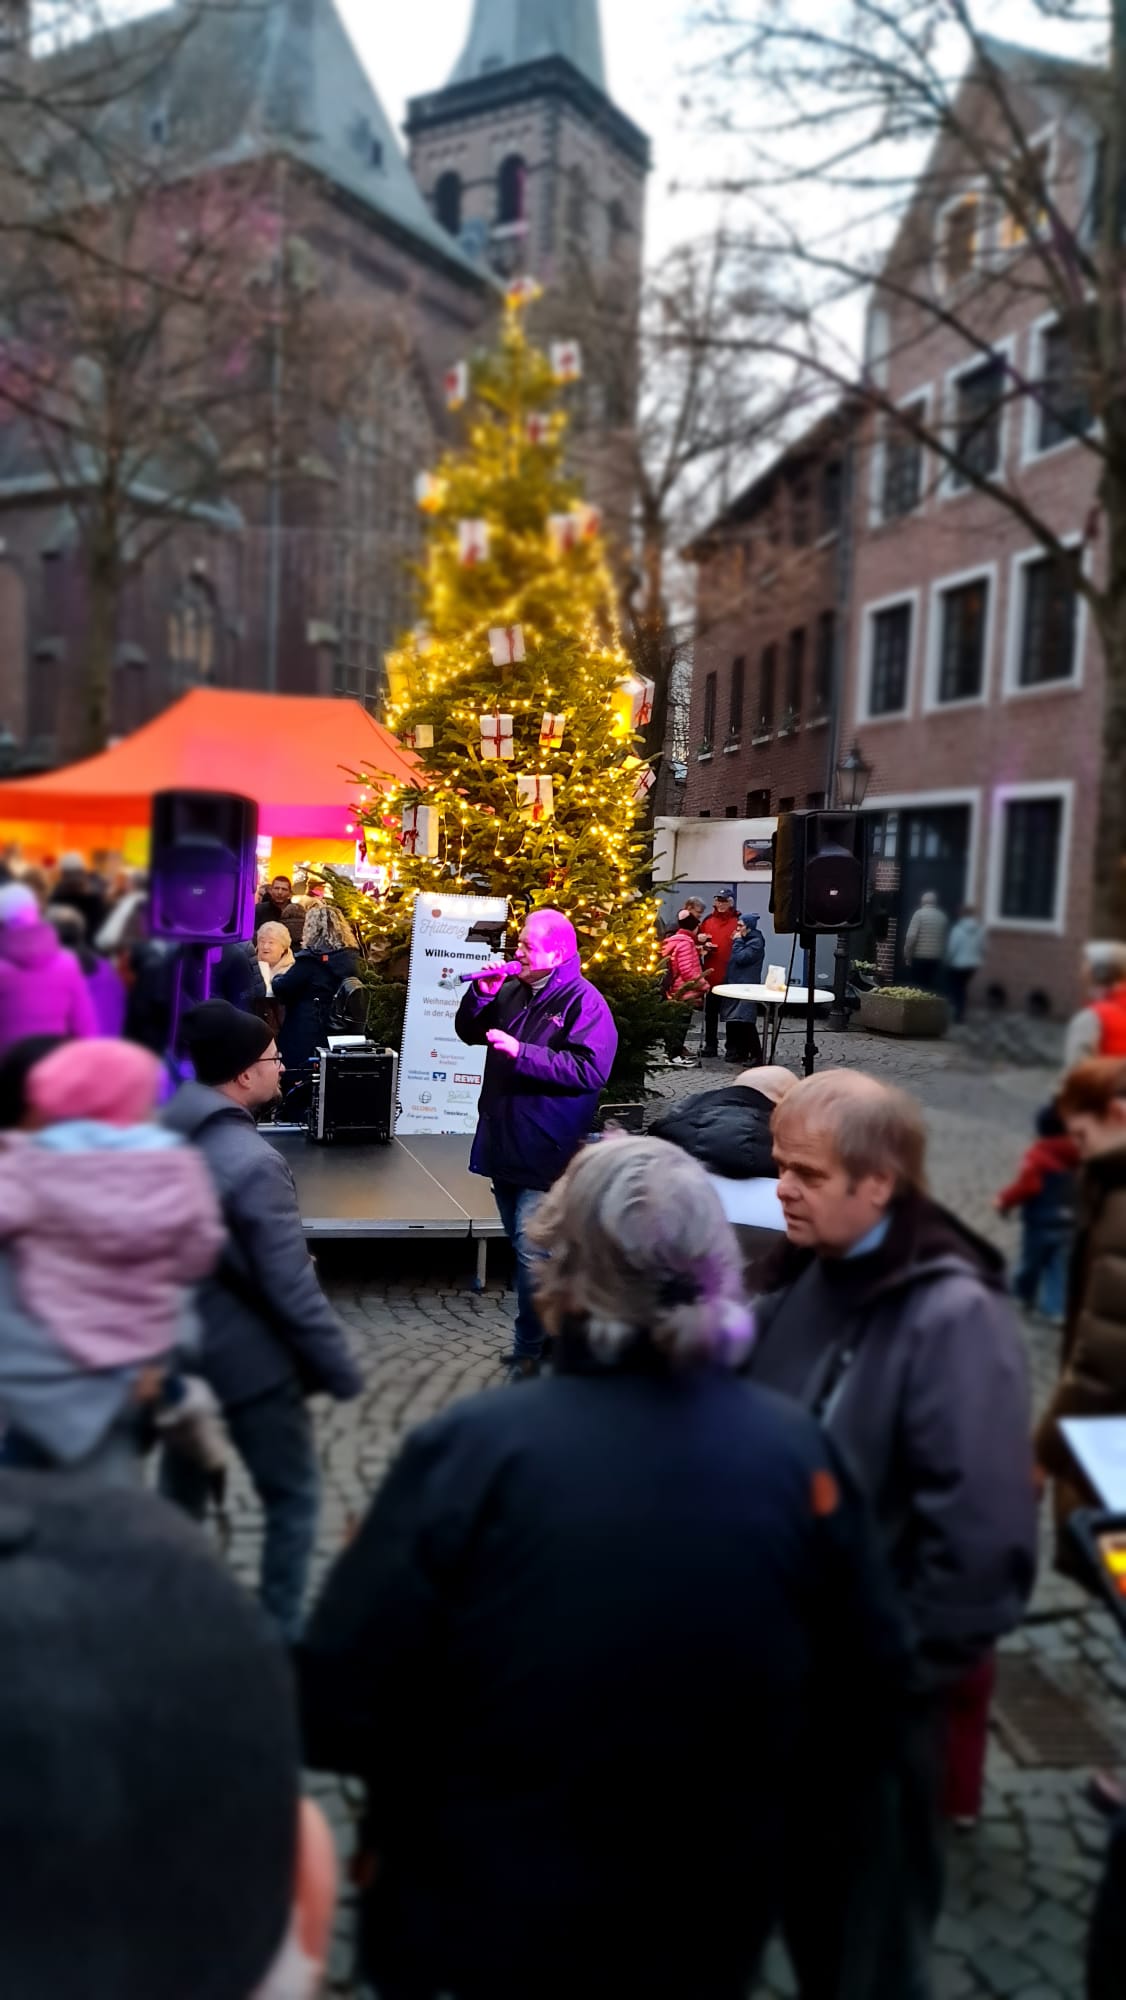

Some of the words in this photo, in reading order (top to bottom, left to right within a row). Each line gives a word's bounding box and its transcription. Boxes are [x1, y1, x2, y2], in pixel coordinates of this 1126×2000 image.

[425, 948, 491, 961] Willkommen!
[422, 997, 460, 1006] Weihnacht
[423, 1008, 431, 1016] in
[432, 1009, 444, 1017] der
[454, 1073, 481, 1084] REWE
